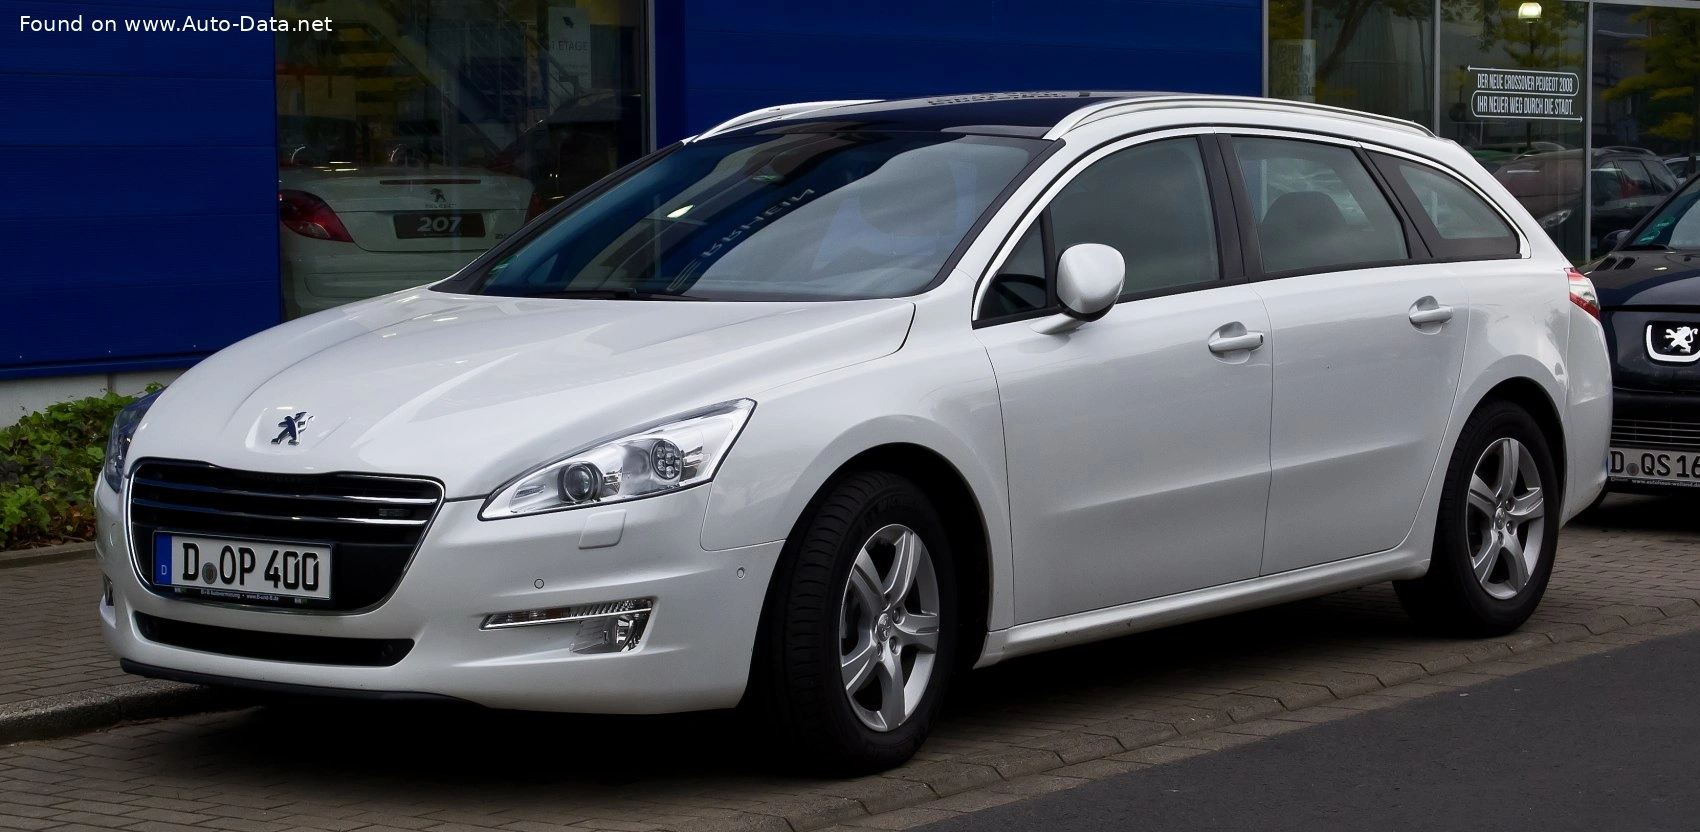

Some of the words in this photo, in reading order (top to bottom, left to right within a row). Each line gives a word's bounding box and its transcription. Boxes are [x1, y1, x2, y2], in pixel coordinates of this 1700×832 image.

[1477, 73, 1488, 89] DER
[1489, 74, 1503, 89] NEUE
[1504, 75, 1535, 90] CROSSOVER
[1536, 77, 1558, 91] PEUGEOT
[1559, 78, 1573, 92] 2008
[1477, 95, 1488, 112] IHR
[1489, 96, 1509, 113] NEUER
[1510, 97, 1523, 114] WEG
[1524, 98, 1543, 114] DURCH
[1544, 99, 1553, 114] DIE
[1555, 99, 1574, 115] STADT.
[417, 216, 463, 232] 207
[1610, 450, 1625, 474] D
[1640, 452, 1671, 477] QS
[161, 564, 168, 575] D
[182, 542, 200, 581] D
[219, 544, 256, 586] OP
[264, 549, 320, 592] 400
